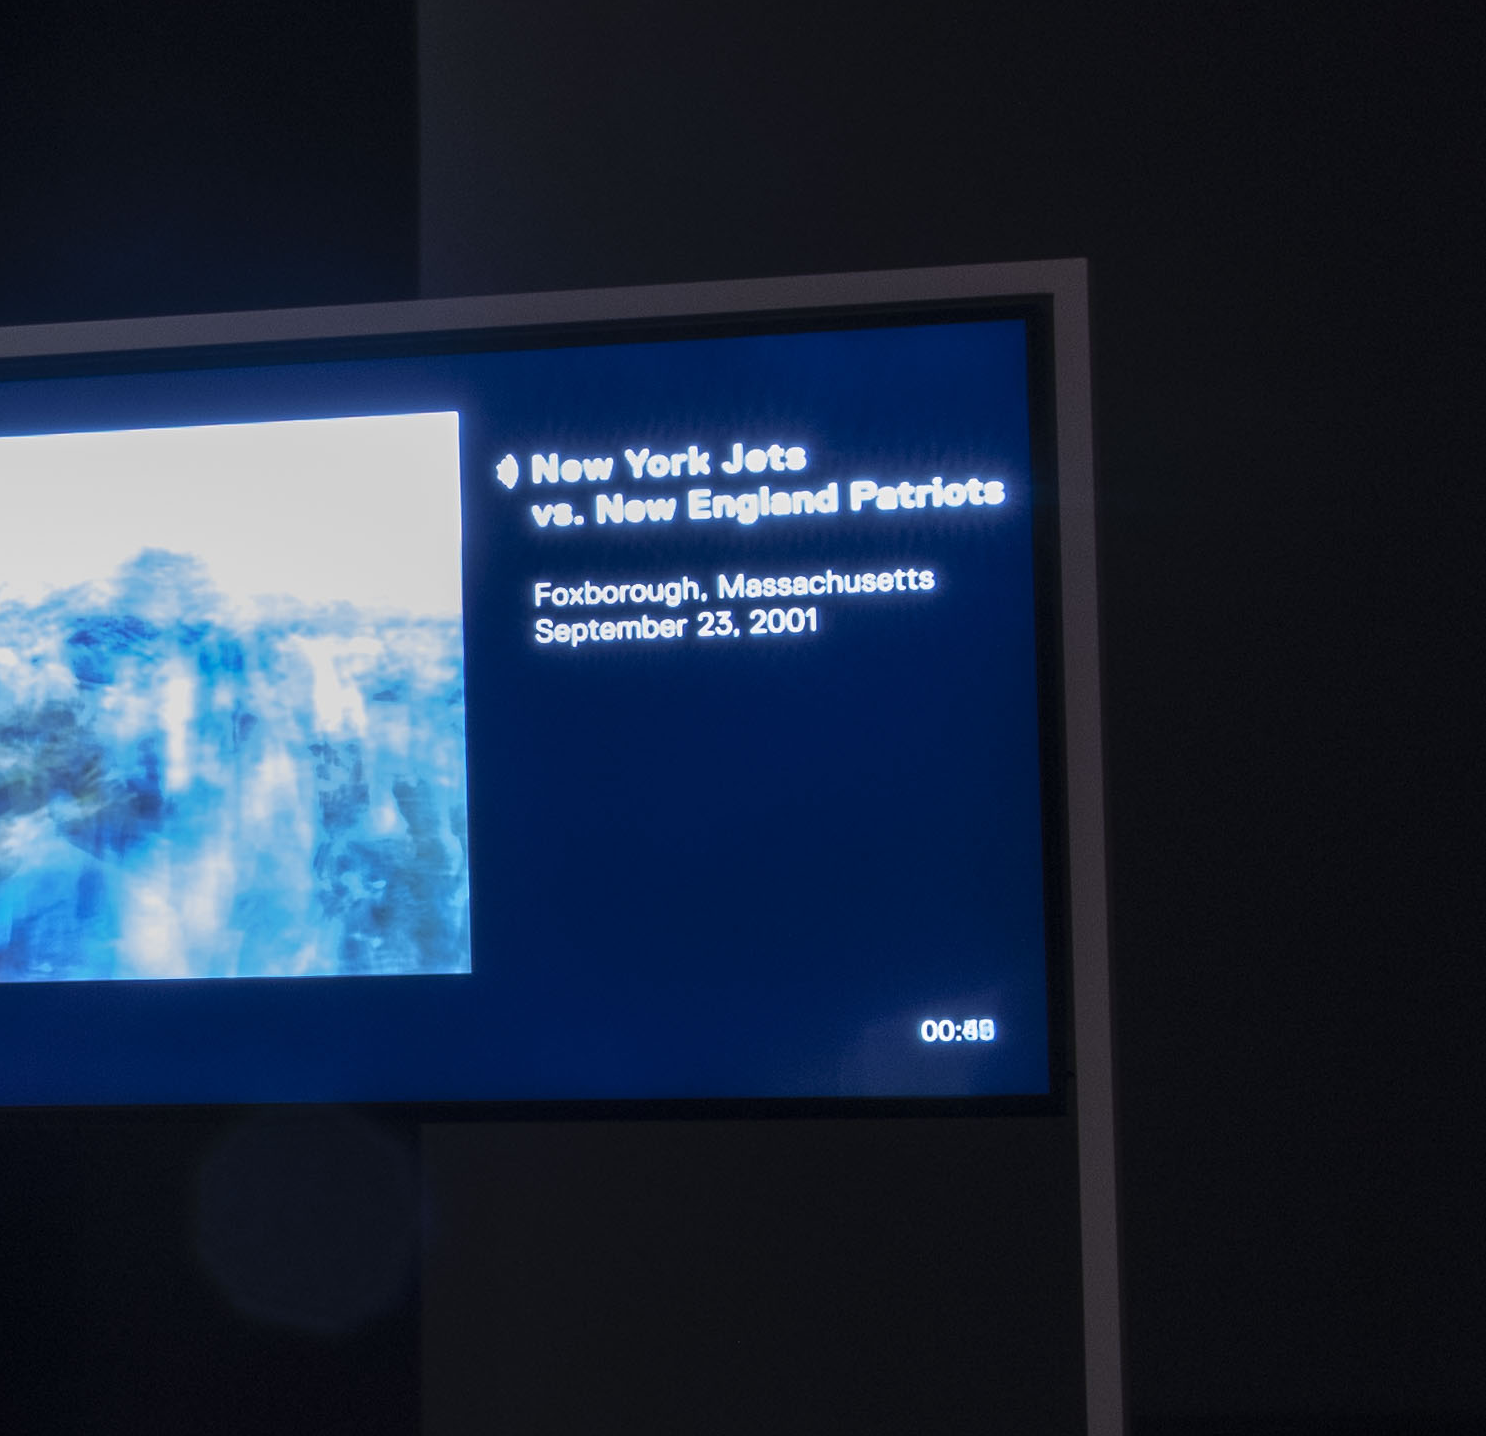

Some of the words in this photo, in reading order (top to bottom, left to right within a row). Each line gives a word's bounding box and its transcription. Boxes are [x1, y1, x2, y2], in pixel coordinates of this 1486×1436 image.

[531, 452, 613, 484] New
[625, 447, 711, 479] York
[722, 443, 808, 475] Jets
[531, 504, 585, 528] vs.
[596, 493, 677, 525] New
[688, 483, 838, 525] England
[850, 476, 1006, 512] Patriots
[534, 574, 709, 608] Foxborough,
[718, 567, 936, 601] Massachusetts
[534, 613, 688, 647] September
[697, 612, 740, 637] 23,
[749, 607, 818, 635] 2001
